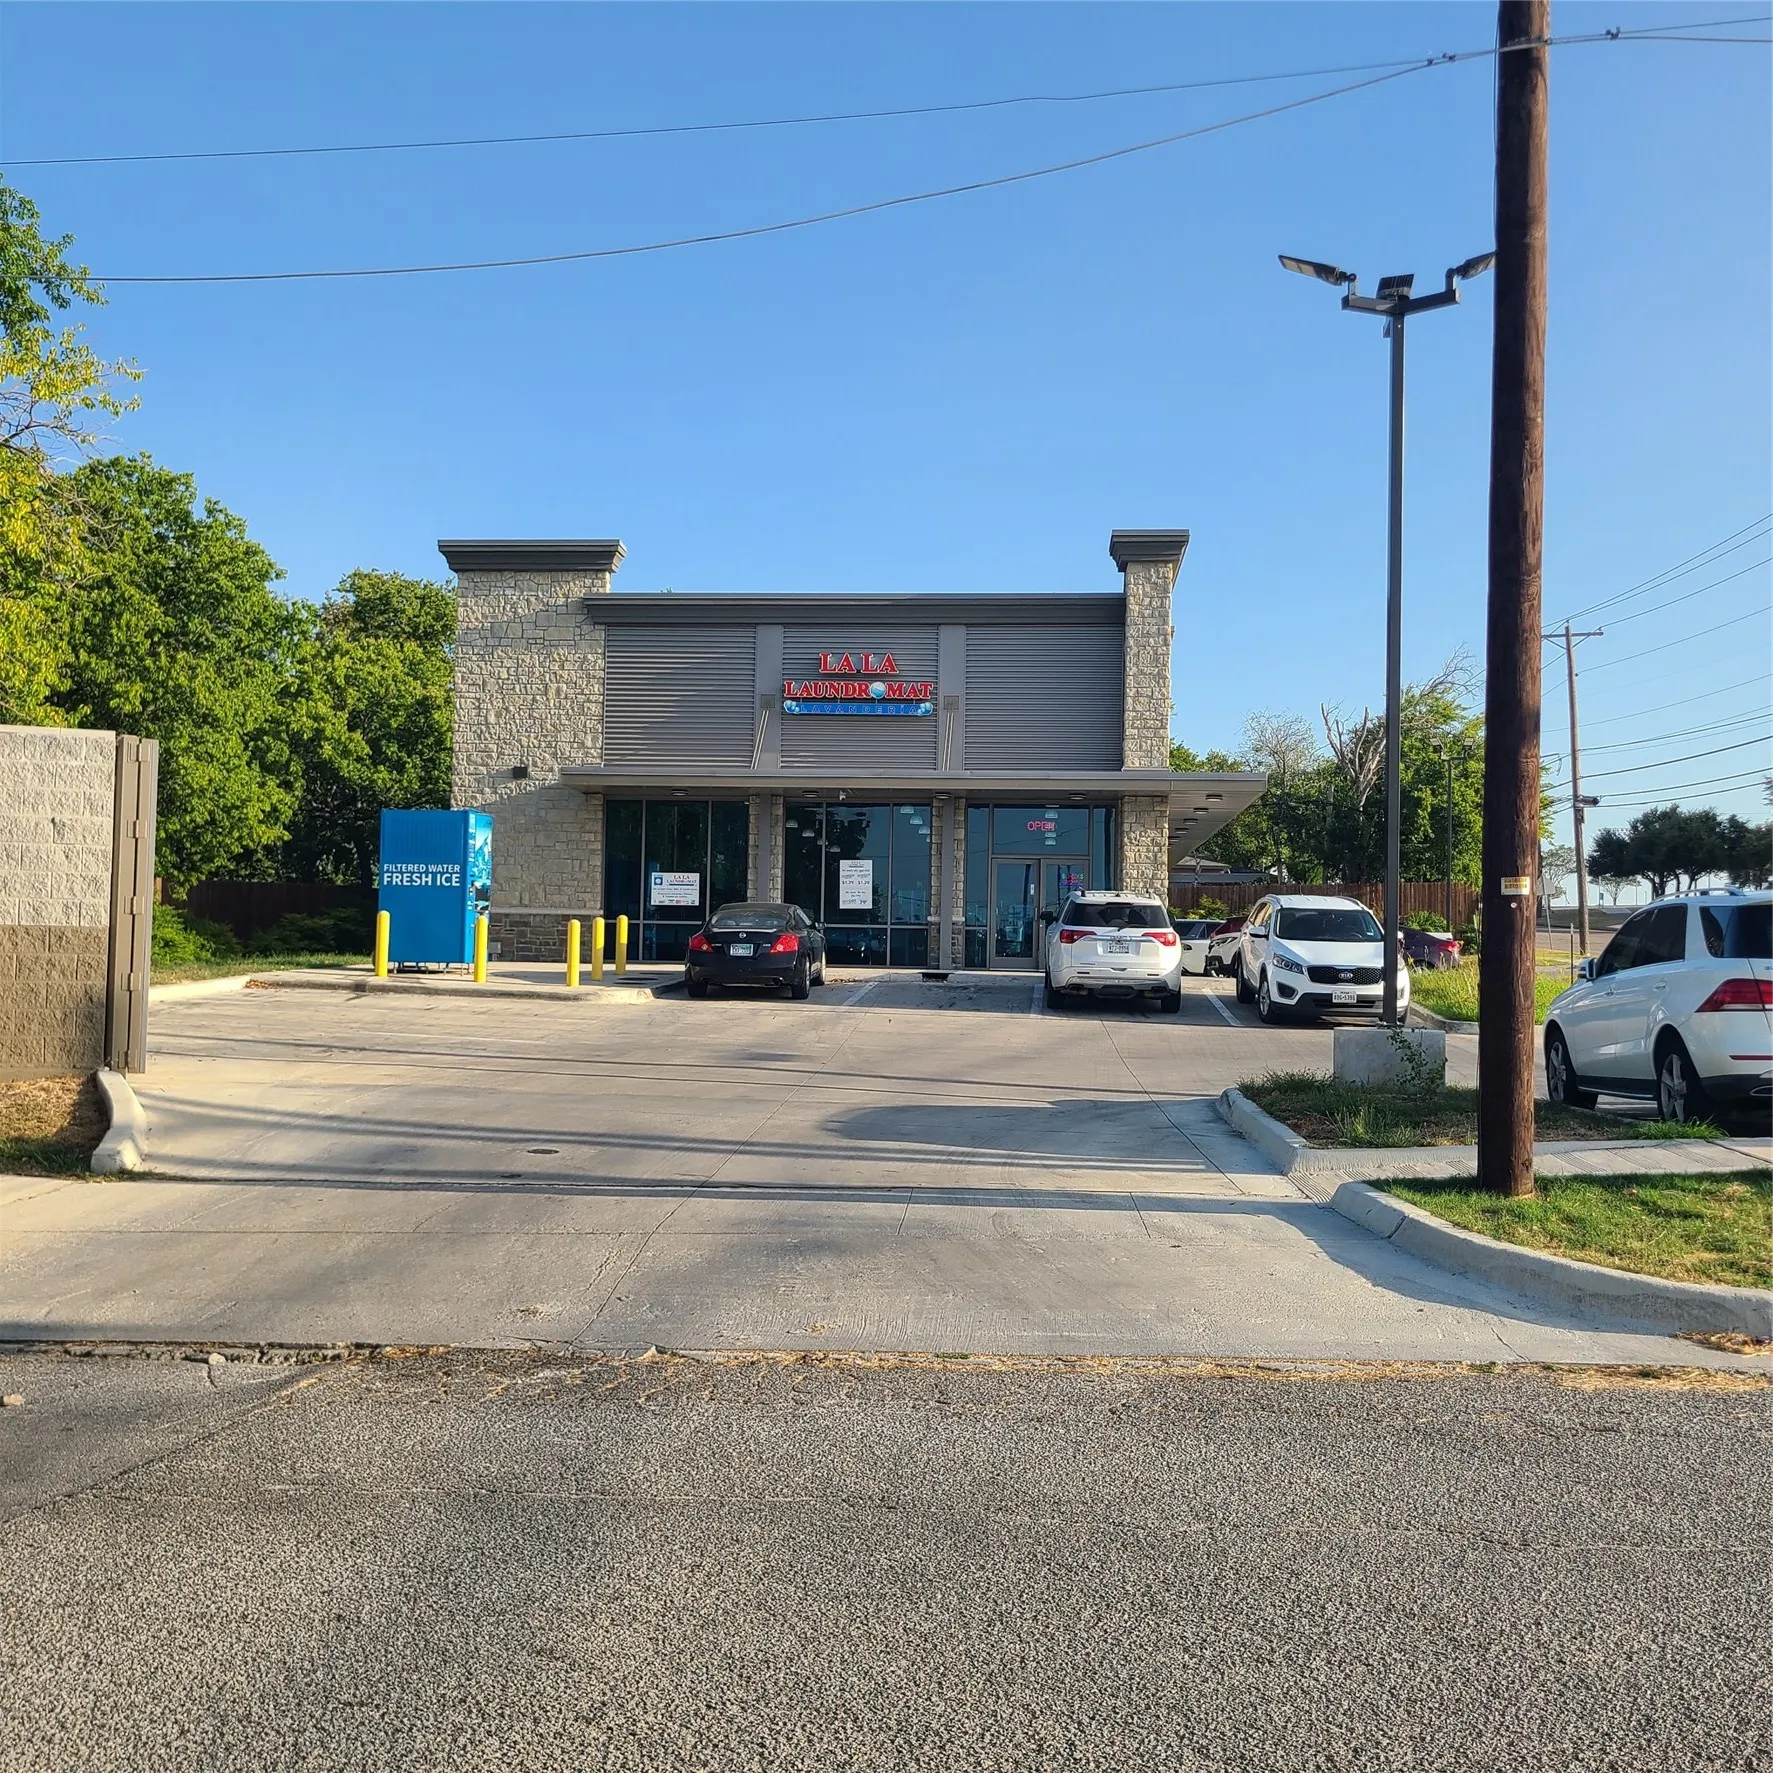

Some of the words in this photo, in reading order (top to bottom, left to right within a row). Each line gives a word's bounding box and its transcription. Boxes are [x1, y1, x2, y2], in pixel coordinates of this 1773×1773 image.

[819, 652, 856, 674] LA
[861, 652, 899, 674] LA
[1028, 821, 1056, 831] OPEN
[383, 864, 426, 872] FILTERED
[428, 864, 460, 873] WATER
[383, 873, 432, 886] FRESH
[436, 873, 460, 886] ICE
